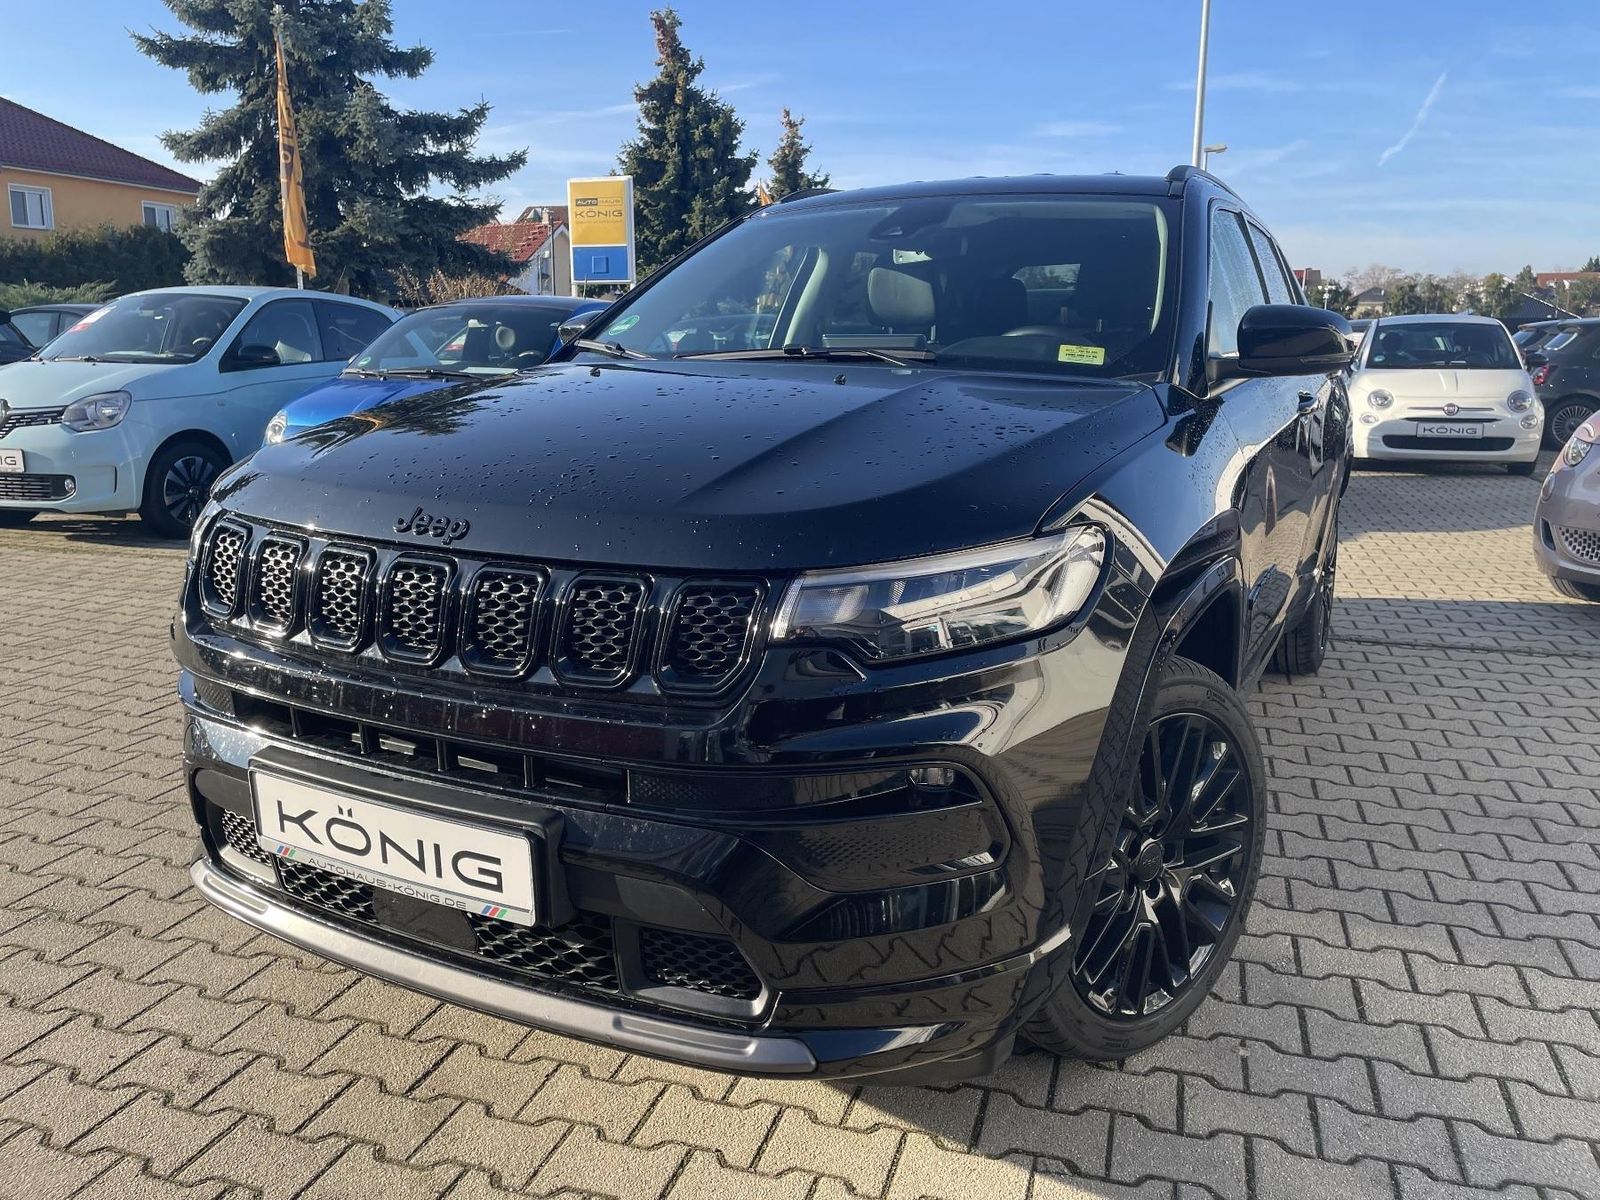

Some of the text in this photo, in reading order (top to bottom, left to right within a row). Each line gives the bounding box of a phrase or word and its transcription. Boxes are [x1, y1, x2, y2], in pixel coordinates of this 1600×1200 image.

[575, 207, 623, 219] KÖNIG
[1423, 425, 1477, 435] KÖNIG
[394, 506, 470, 545] Jeep
[277, 800, 503, 893] KÖNIG
[308, 857, 467, 910] AUTOHAUS-KÖNIG.DE
